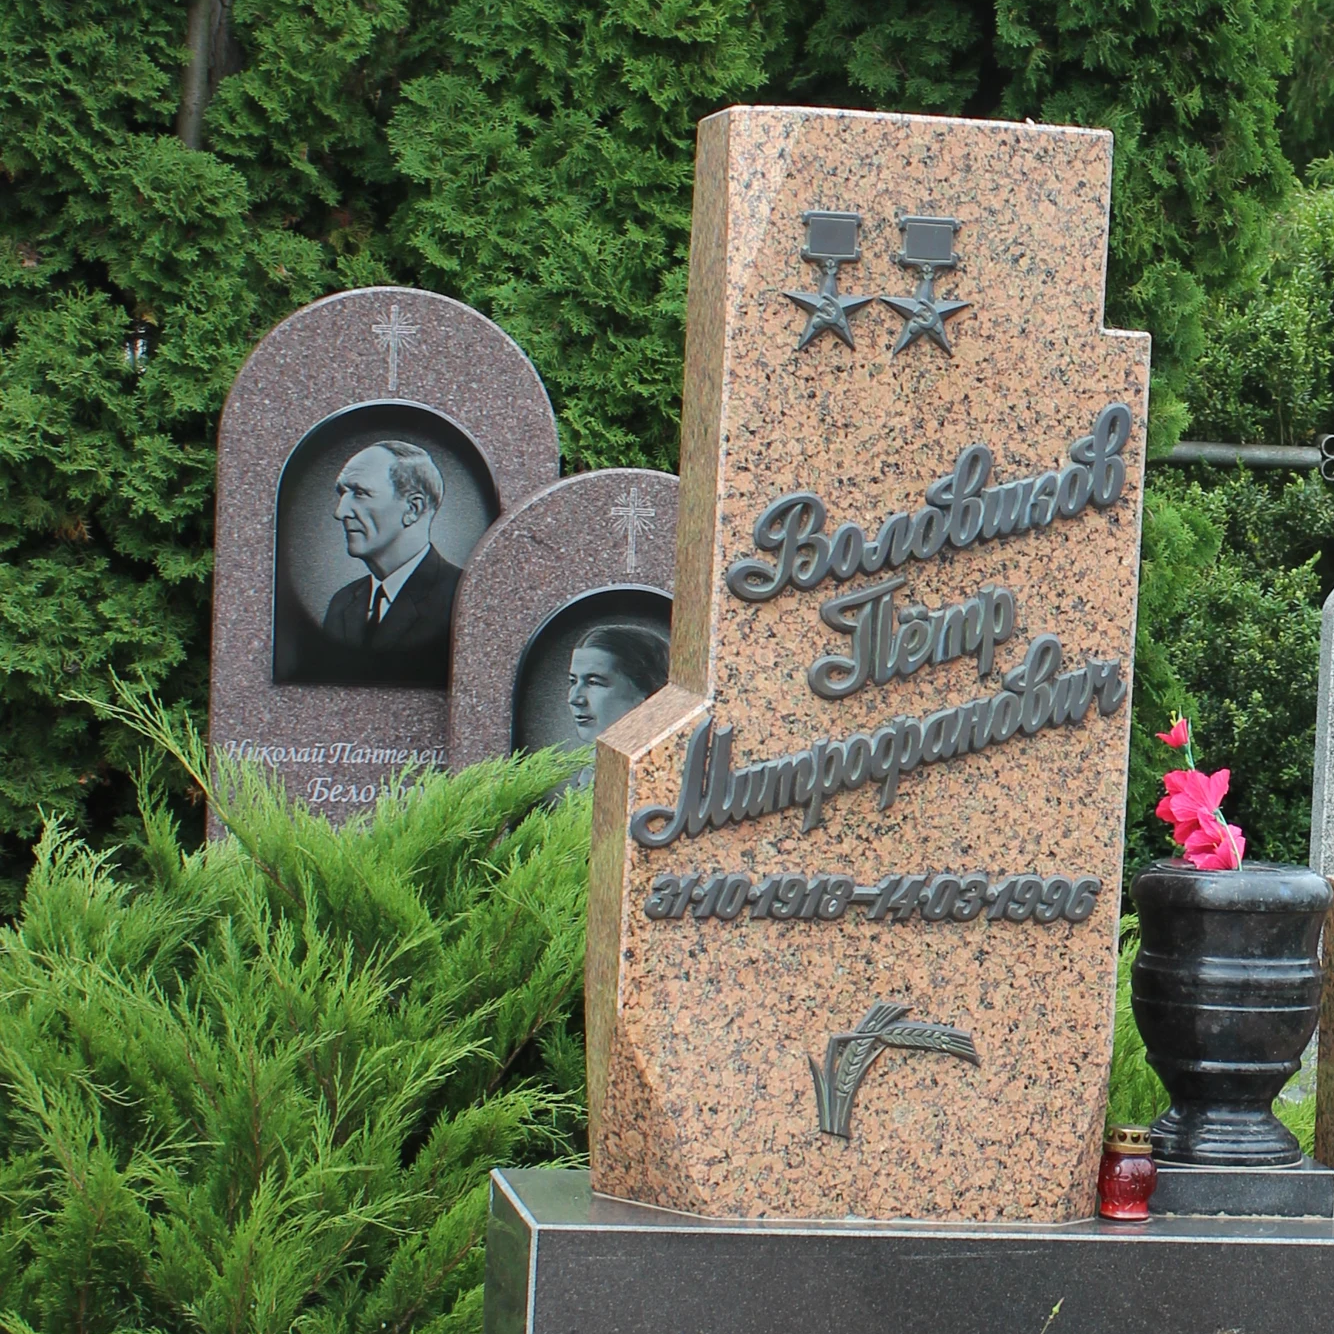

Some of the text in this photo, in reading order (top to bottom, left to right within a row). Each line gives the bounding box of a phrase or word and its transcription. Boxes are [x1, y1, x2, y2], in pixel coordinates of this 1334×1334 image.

[726, 402, 1132, 603] Воловиков
[808, 575, 1015, 700] Пётр
[224, 739, 326, 767] Николай
[630, 632, 1128, 849] Митрофанович
